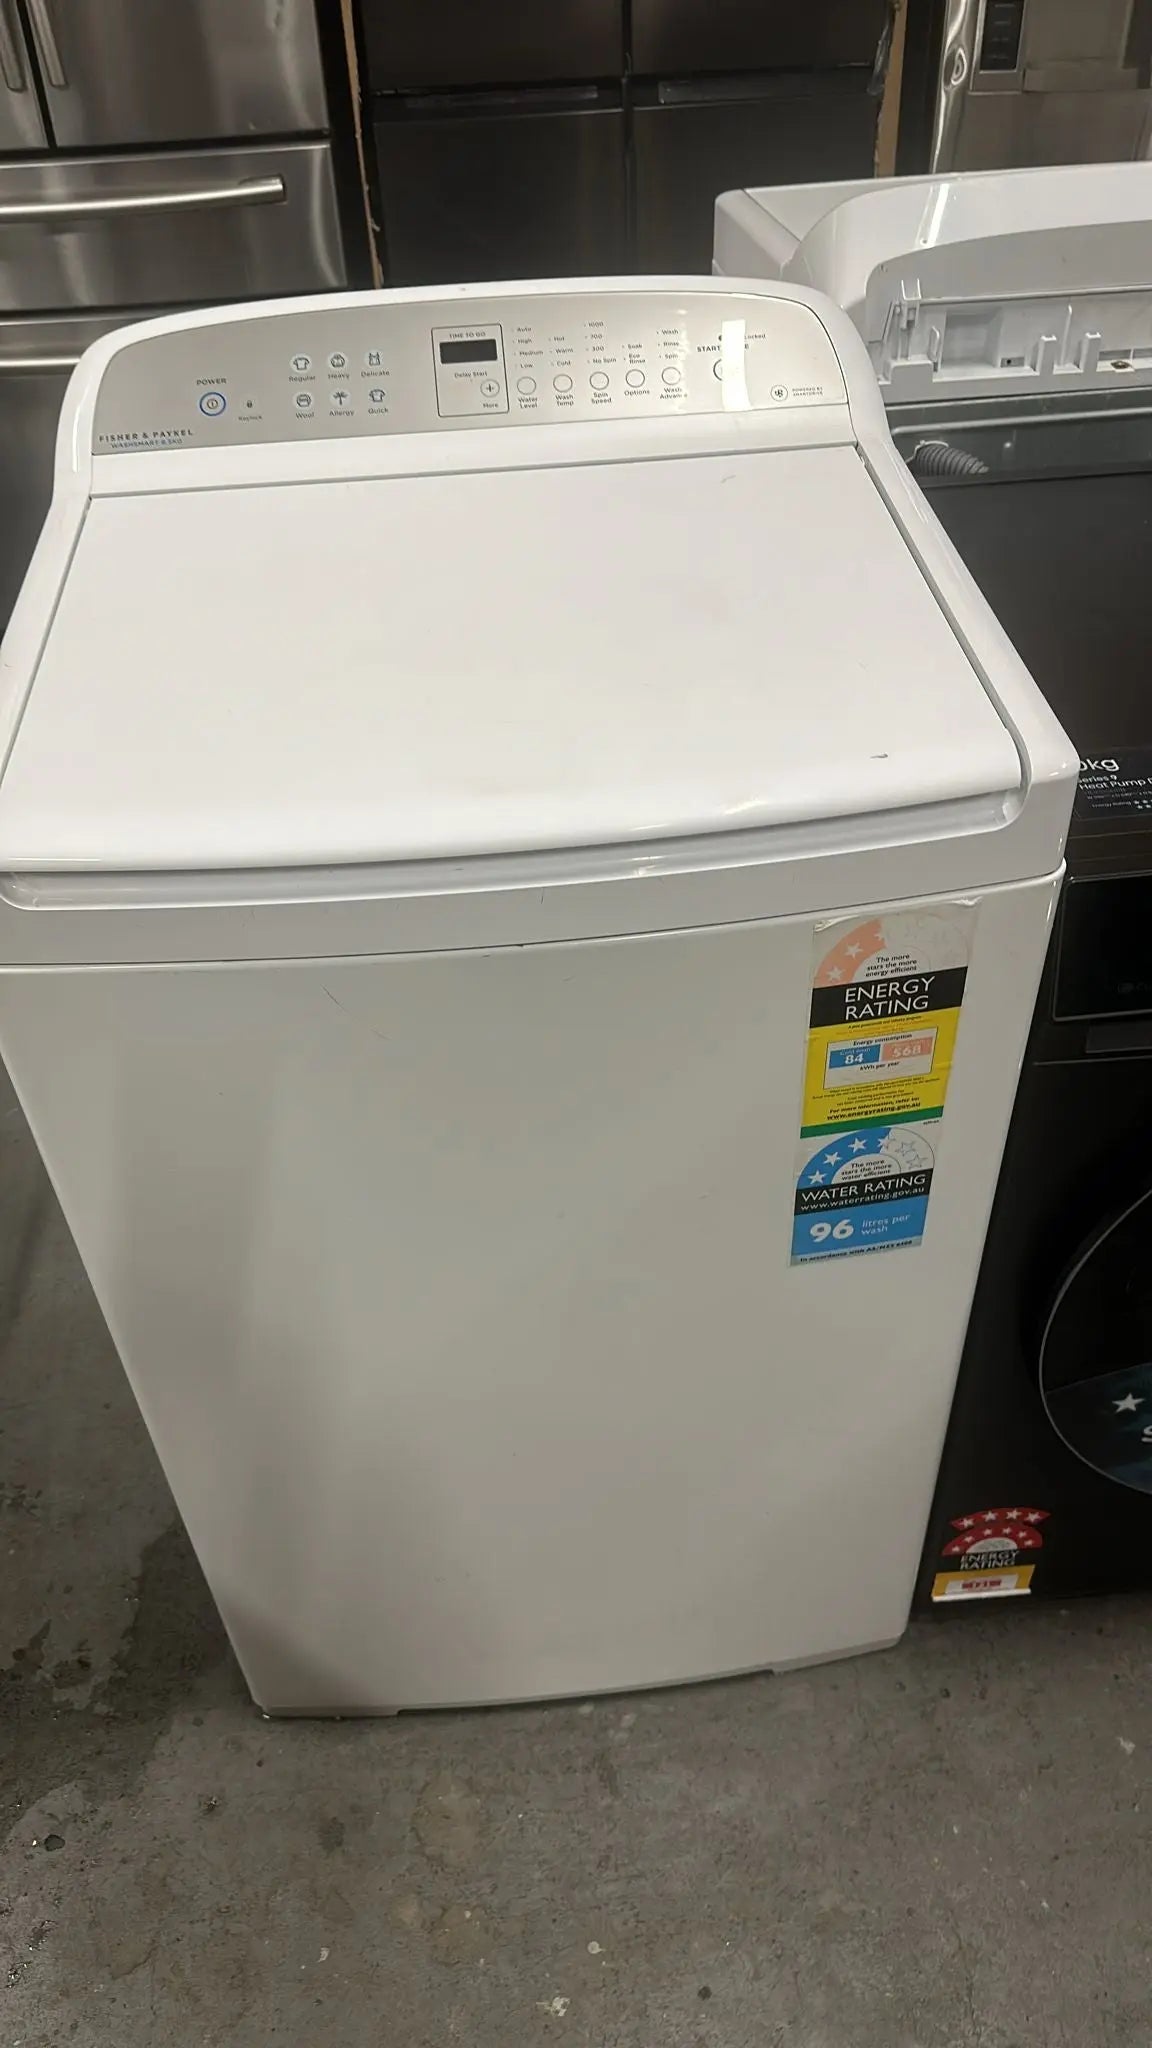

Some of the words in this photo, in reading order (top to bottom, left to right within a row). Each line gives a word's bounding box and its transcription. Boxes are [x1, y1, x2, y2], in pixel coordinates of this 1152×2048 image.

[288, 375, 316, 383] Regular
[361, 370, 390, 378] Delicate
[196, 377, 227, 386] POWER
[99, 433, 138, 442] FISHER
[152, 429, 193, 438] PAYKEL
[1079, 781, 1109, 790] Heat
[1110, 779, 1146, 788] Pump
[876, 956, 890, 964] The
[898, 959, 917, 967] more
[890, 965, 917, 974] efficient
[845, 976, 936, 1003] ENERGY
[846, 995, 929, 1020] RATING
[853, 1039, 874, 1047] Energy
[874, 1033, 913, 1043] consumption
[844, 1053, 864, 1065] 84
[857, 1100, 894, 1110] information,
[827, 1102, 921, 1121] www.energyrating.gov.au
[865, 1159, 885, 1167] more
[841, 1168, 858, 1176] stars
[841, 1173, 862, 1181] water
[864, 1169, 891, 1178] efficient
[801, 1185, 859, 1202] WATER
[864, 1174, 926, 1193] RATING
[800, 1187, 925, 1211] www.waterrating.gov.au
[810, 1219, 854, 1243] 96
[861, 1218, 889, 1228] litres
[891, 1213, 911, 1225] per
[861, 1227, 888, 1235] wash
[809, 1251, 848, 1261] accordance
[960, 1550, 1020, 1562] ENERGY
[960, 1559, 1016, 1570] RATING
